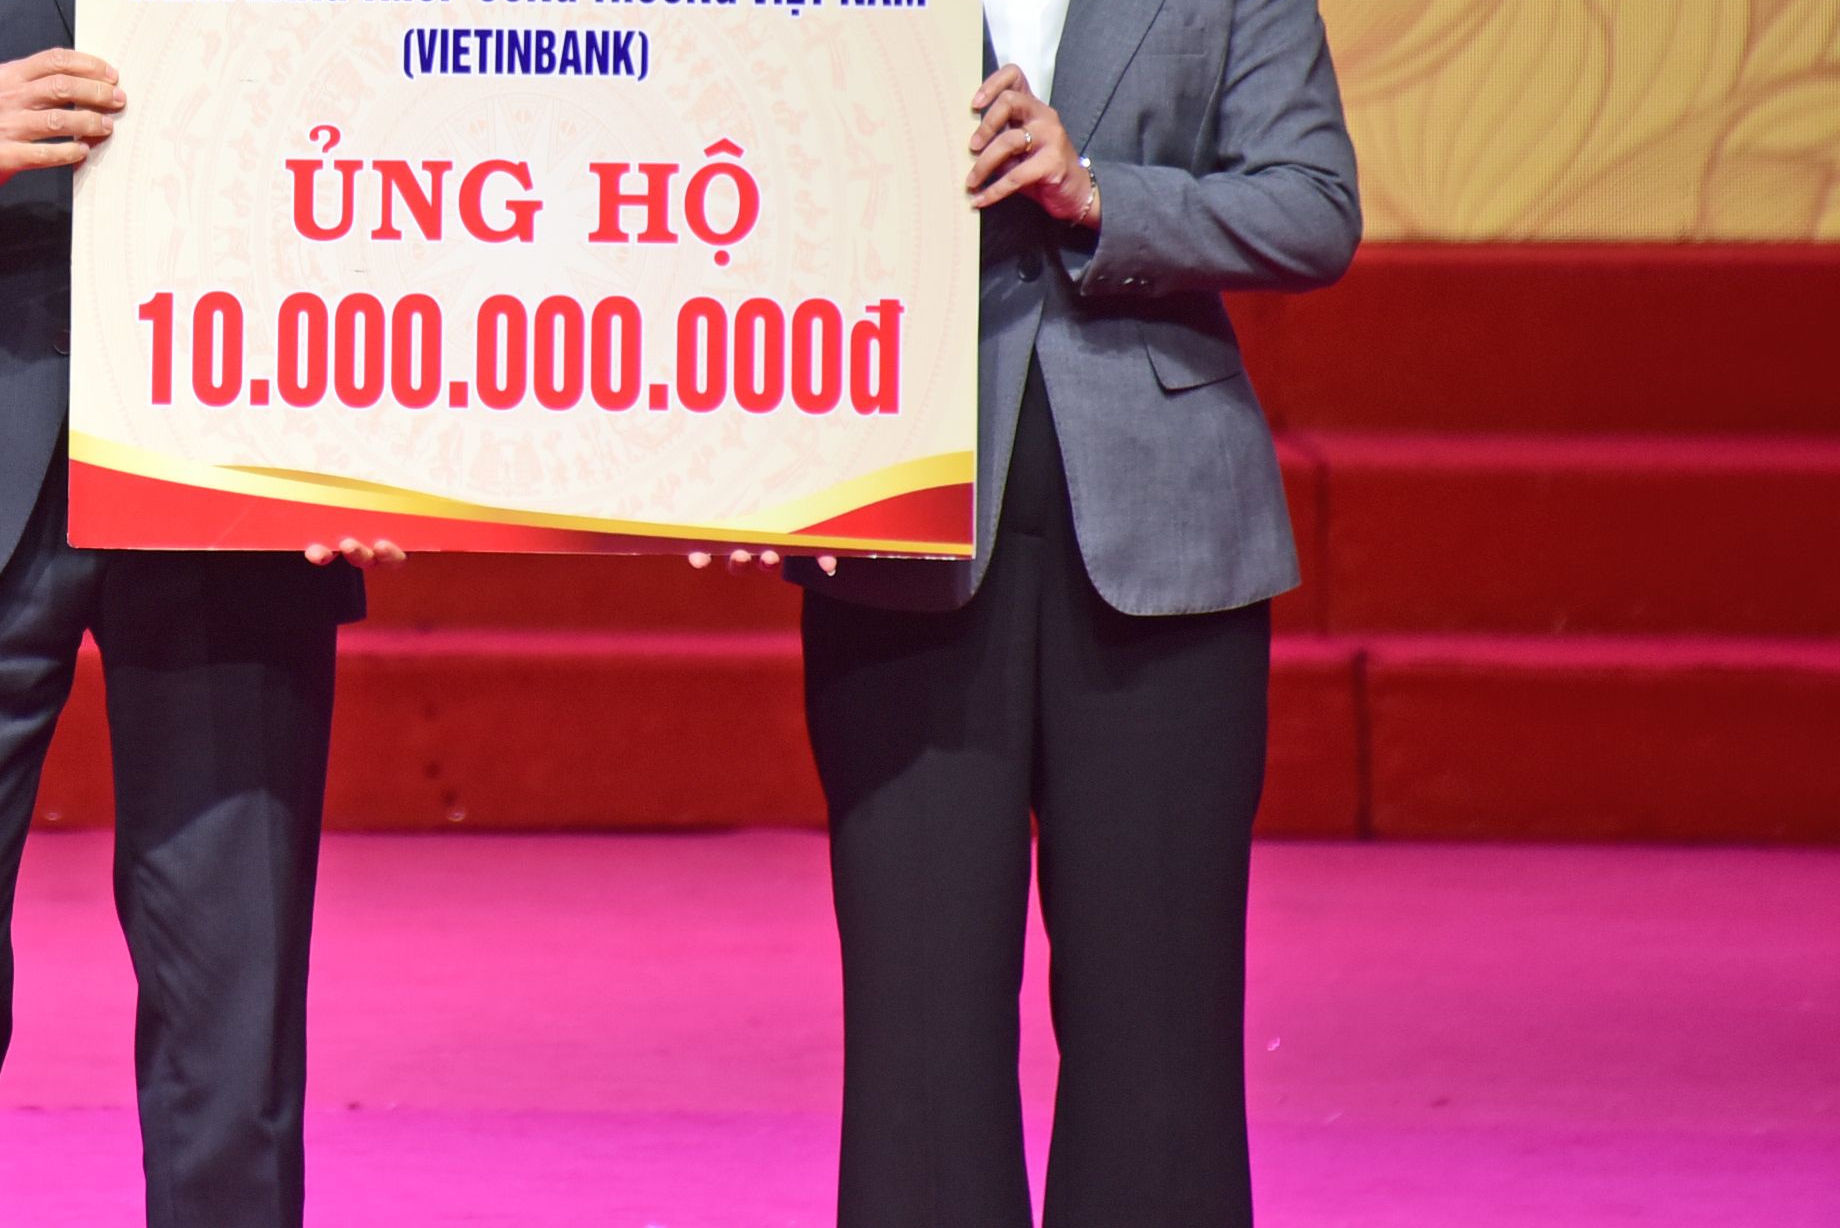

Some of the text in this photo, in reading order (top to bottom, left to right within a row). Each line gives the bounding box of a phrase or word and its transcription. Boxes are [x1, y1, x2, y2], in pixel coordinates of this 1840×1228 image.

[402, 27, 650, 81] (VIETINBANK)
[286, 124, 762, 267] ỦNG HỘ
[137, 291, 906, 417] 10.000.000.000đ
